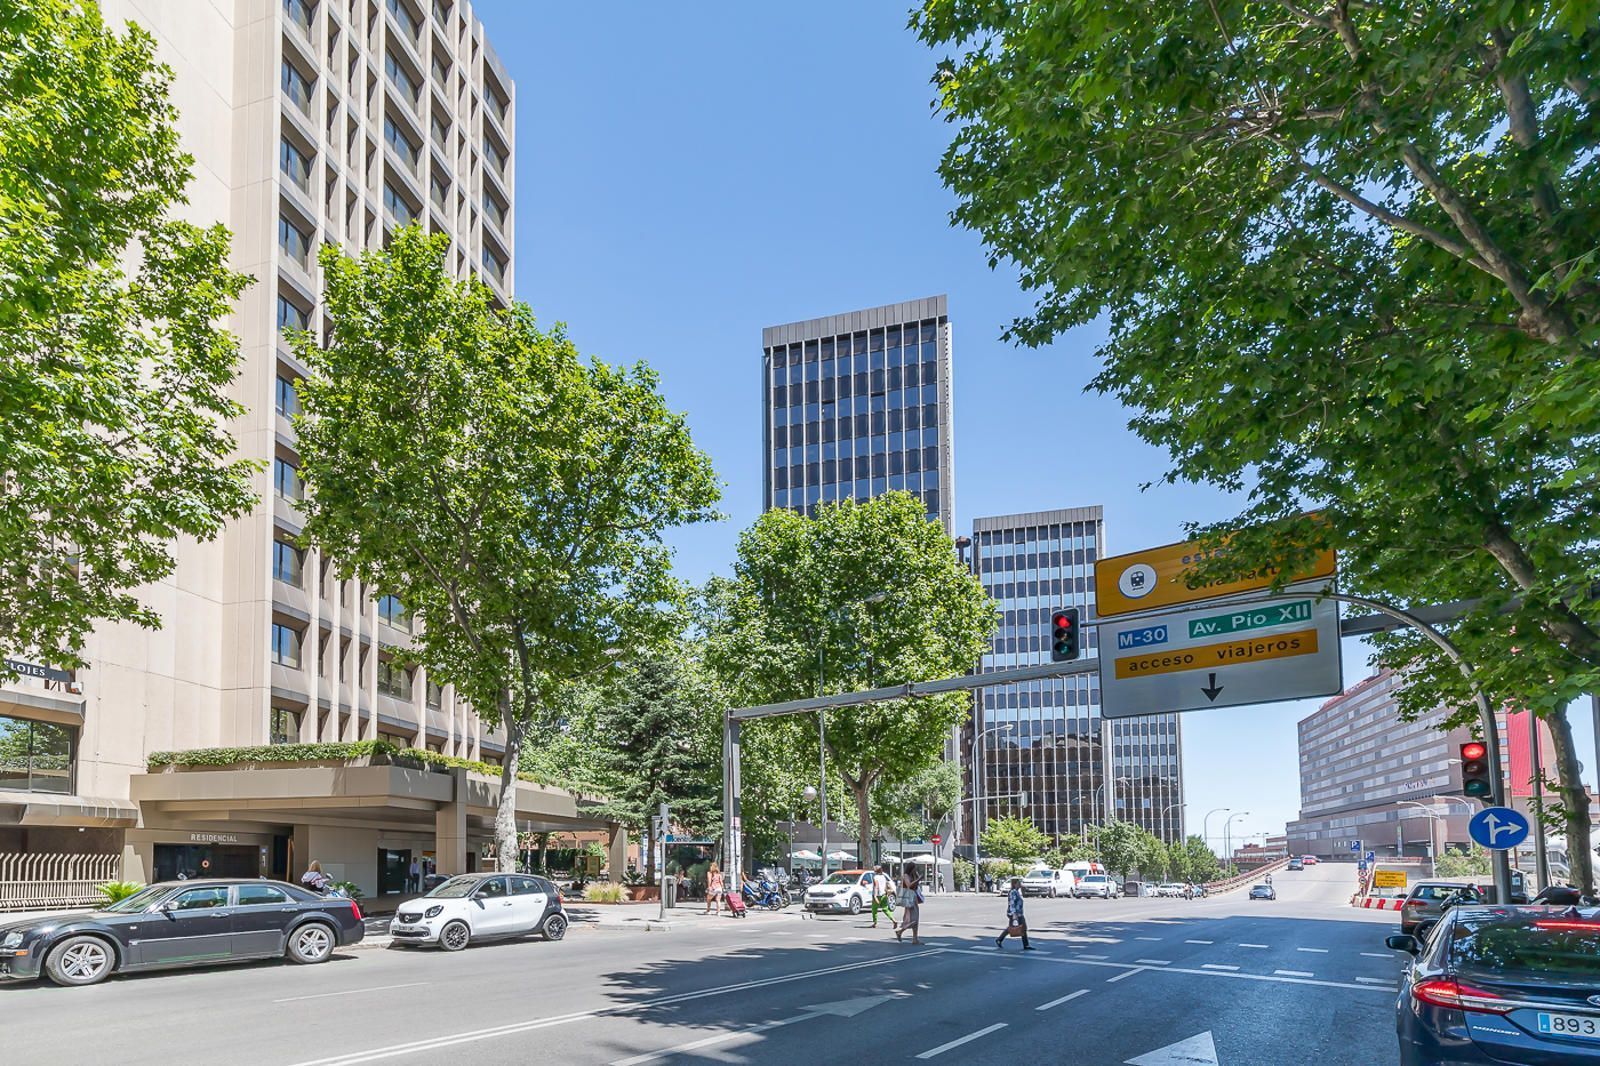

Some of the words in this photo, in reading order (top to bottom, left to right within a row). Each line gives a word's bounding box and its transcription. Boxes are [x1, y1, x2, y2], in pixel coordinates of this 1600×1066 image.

[1193, 621, 1222, 636] Av.
[1279, 603, 1309, 622] XII
[1120, 628, 1166, 648] M-30
[1129, 653, 1194, 672] acceso
[1217, 637, 1301, 660] viajeros
[191, 833, 238, 842] RESIDENCIAL
[1553, 1017, 1596, 1035] 893
